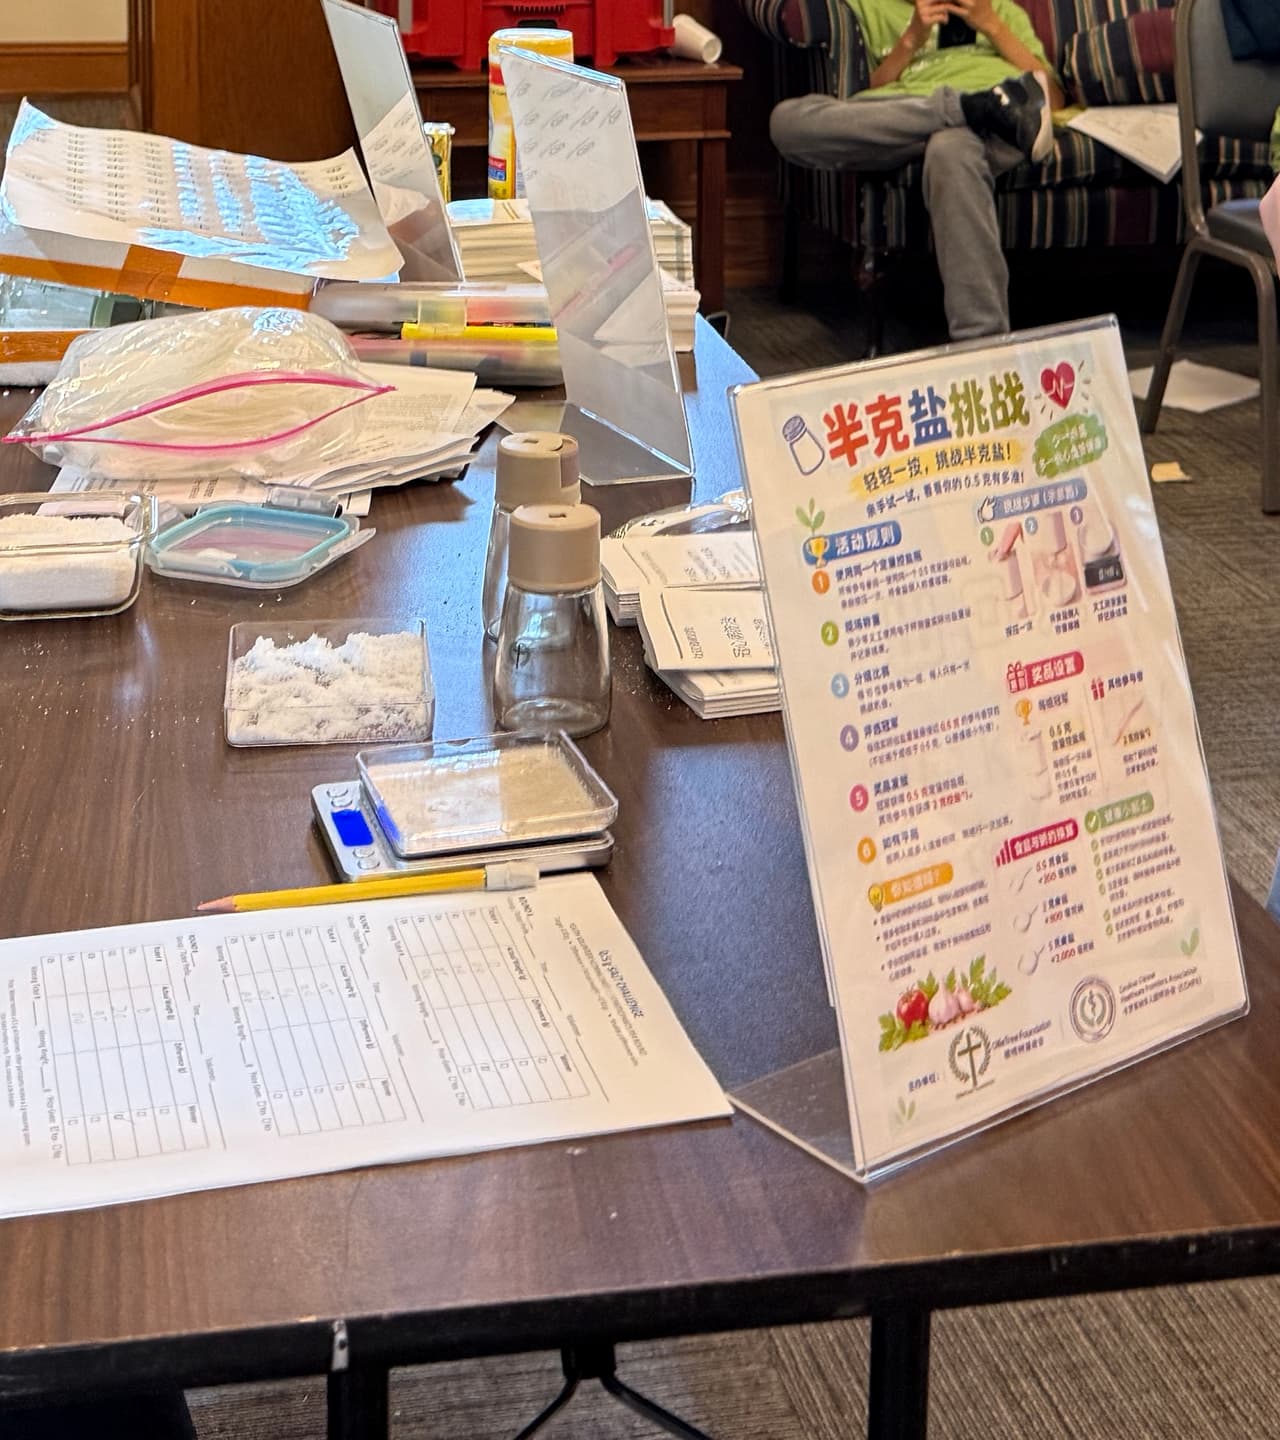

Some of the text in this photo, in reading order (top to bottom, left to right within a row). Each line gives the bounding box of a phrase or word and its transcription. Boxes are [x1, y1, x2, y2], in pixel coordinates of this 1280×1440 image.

[820, 367, 1032, 470] 半克盐挑战
[834, 524, 895, 555] 活动规则
[1030, 655, 1076, 683] 奖品设置
[614, 981, 643, 1018] CHALLENGE
[1017, 1019, 1052, 1040] Foundation
